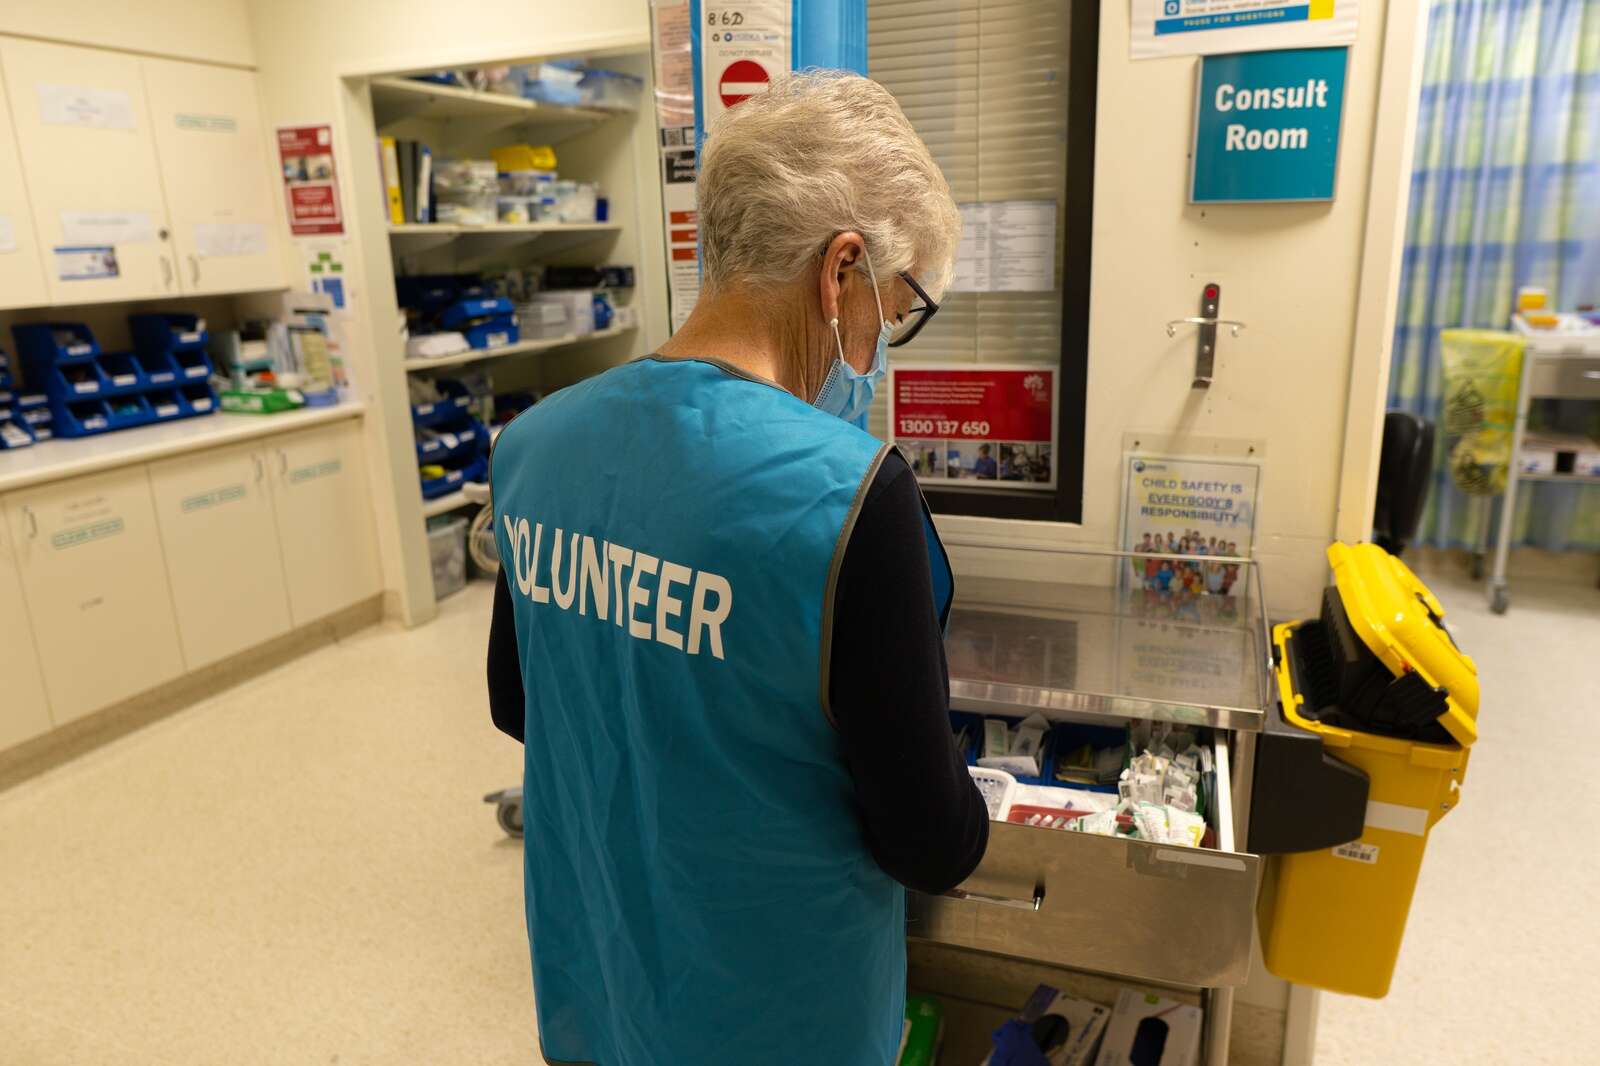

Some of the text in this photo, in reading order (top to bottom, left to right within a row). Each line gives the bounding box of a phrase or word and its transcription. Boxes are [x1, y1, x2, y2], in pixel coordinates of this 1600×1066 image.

[1215, 79, 1328, 112] Consult
[1225, 124, 1309, 151] Room
[900, 419, 990, 436] 1300 137 650
[1142, 478, 1242, 494] CHILD SAFETY IS
[1141, 506, 1239, 524] RESPONSIBILITY
[503, 514, 733, 661] VOLUNTEER
